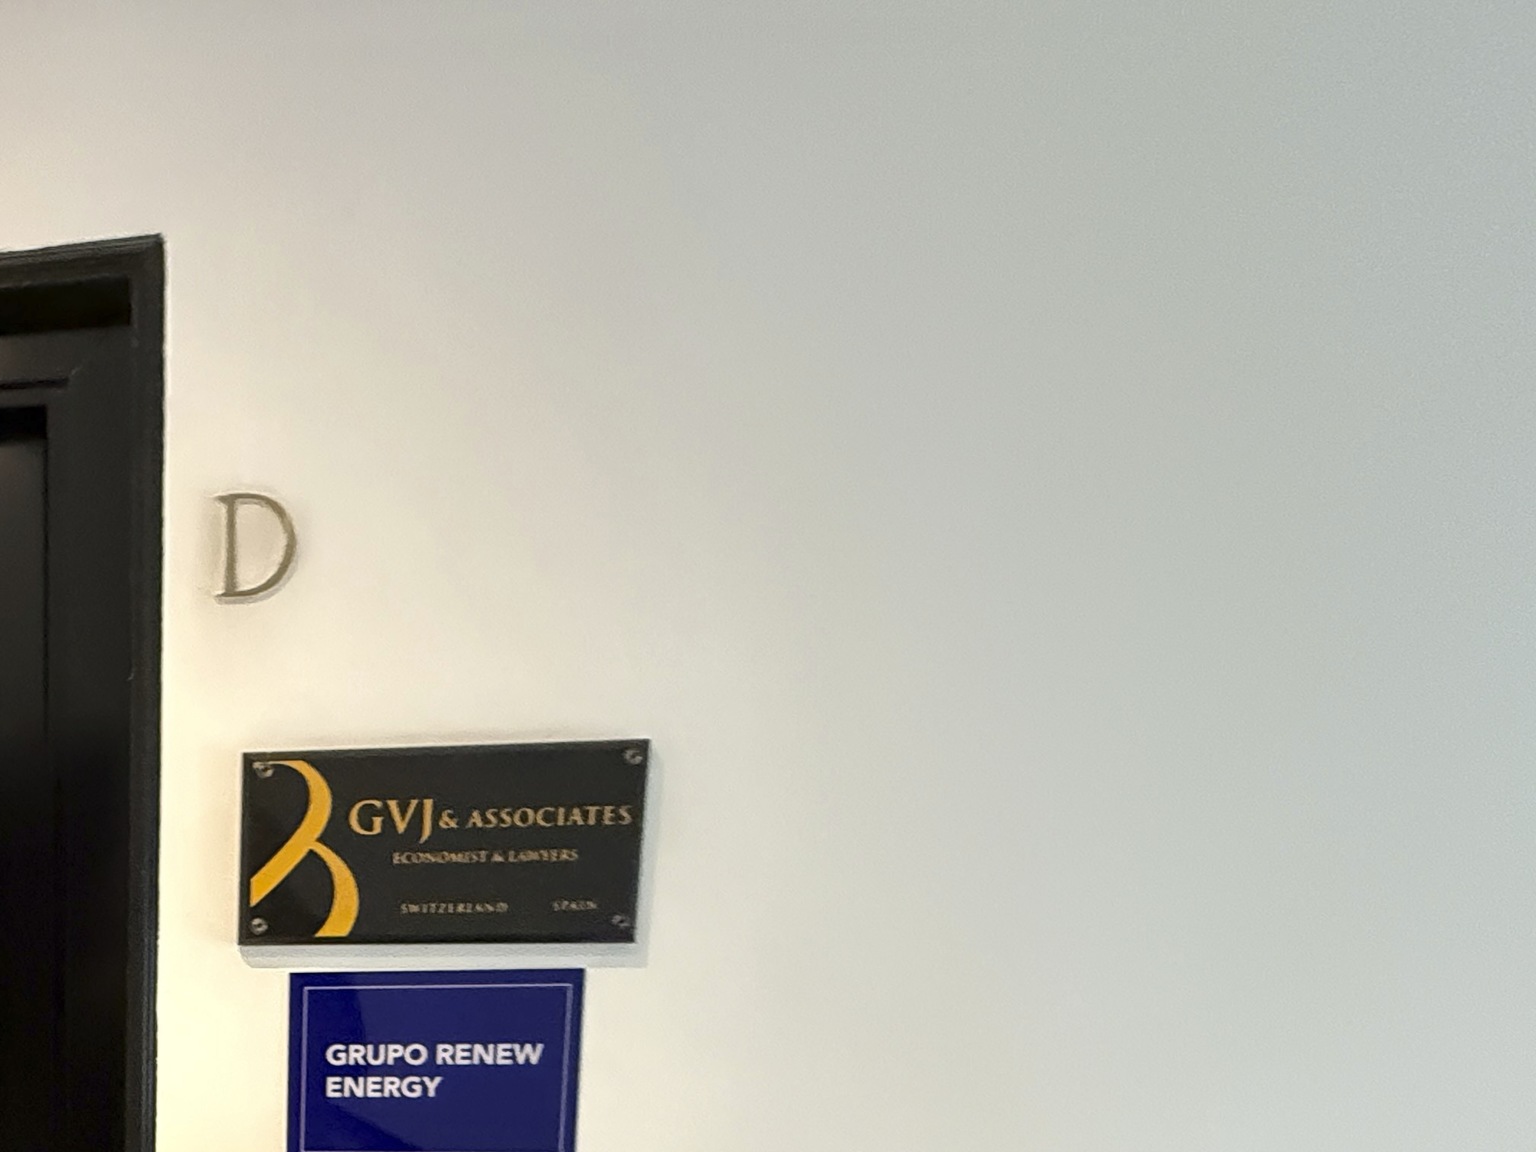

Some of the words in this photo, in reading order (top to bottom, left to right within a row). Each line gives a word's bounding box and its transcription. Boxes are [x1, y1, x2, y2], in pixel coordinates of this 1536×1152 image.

[214, 492, 298, 598] D
[348, 798, 434, 844] GVJ
[438, 809, 459, 830] &
[465, 804, 633, 829] ASSOCIATES
[392, 850, 487, 866] ECONOMIST
[508, 848, 579, 863] LAWYERS
[400, 901, 509, 914] SWITZERLAND
[325, 1043, 429, 1066] GRUPO
[435, 1043, 545, 1066] RENEW
[325, 1076, 443, 1098] ENERGY
